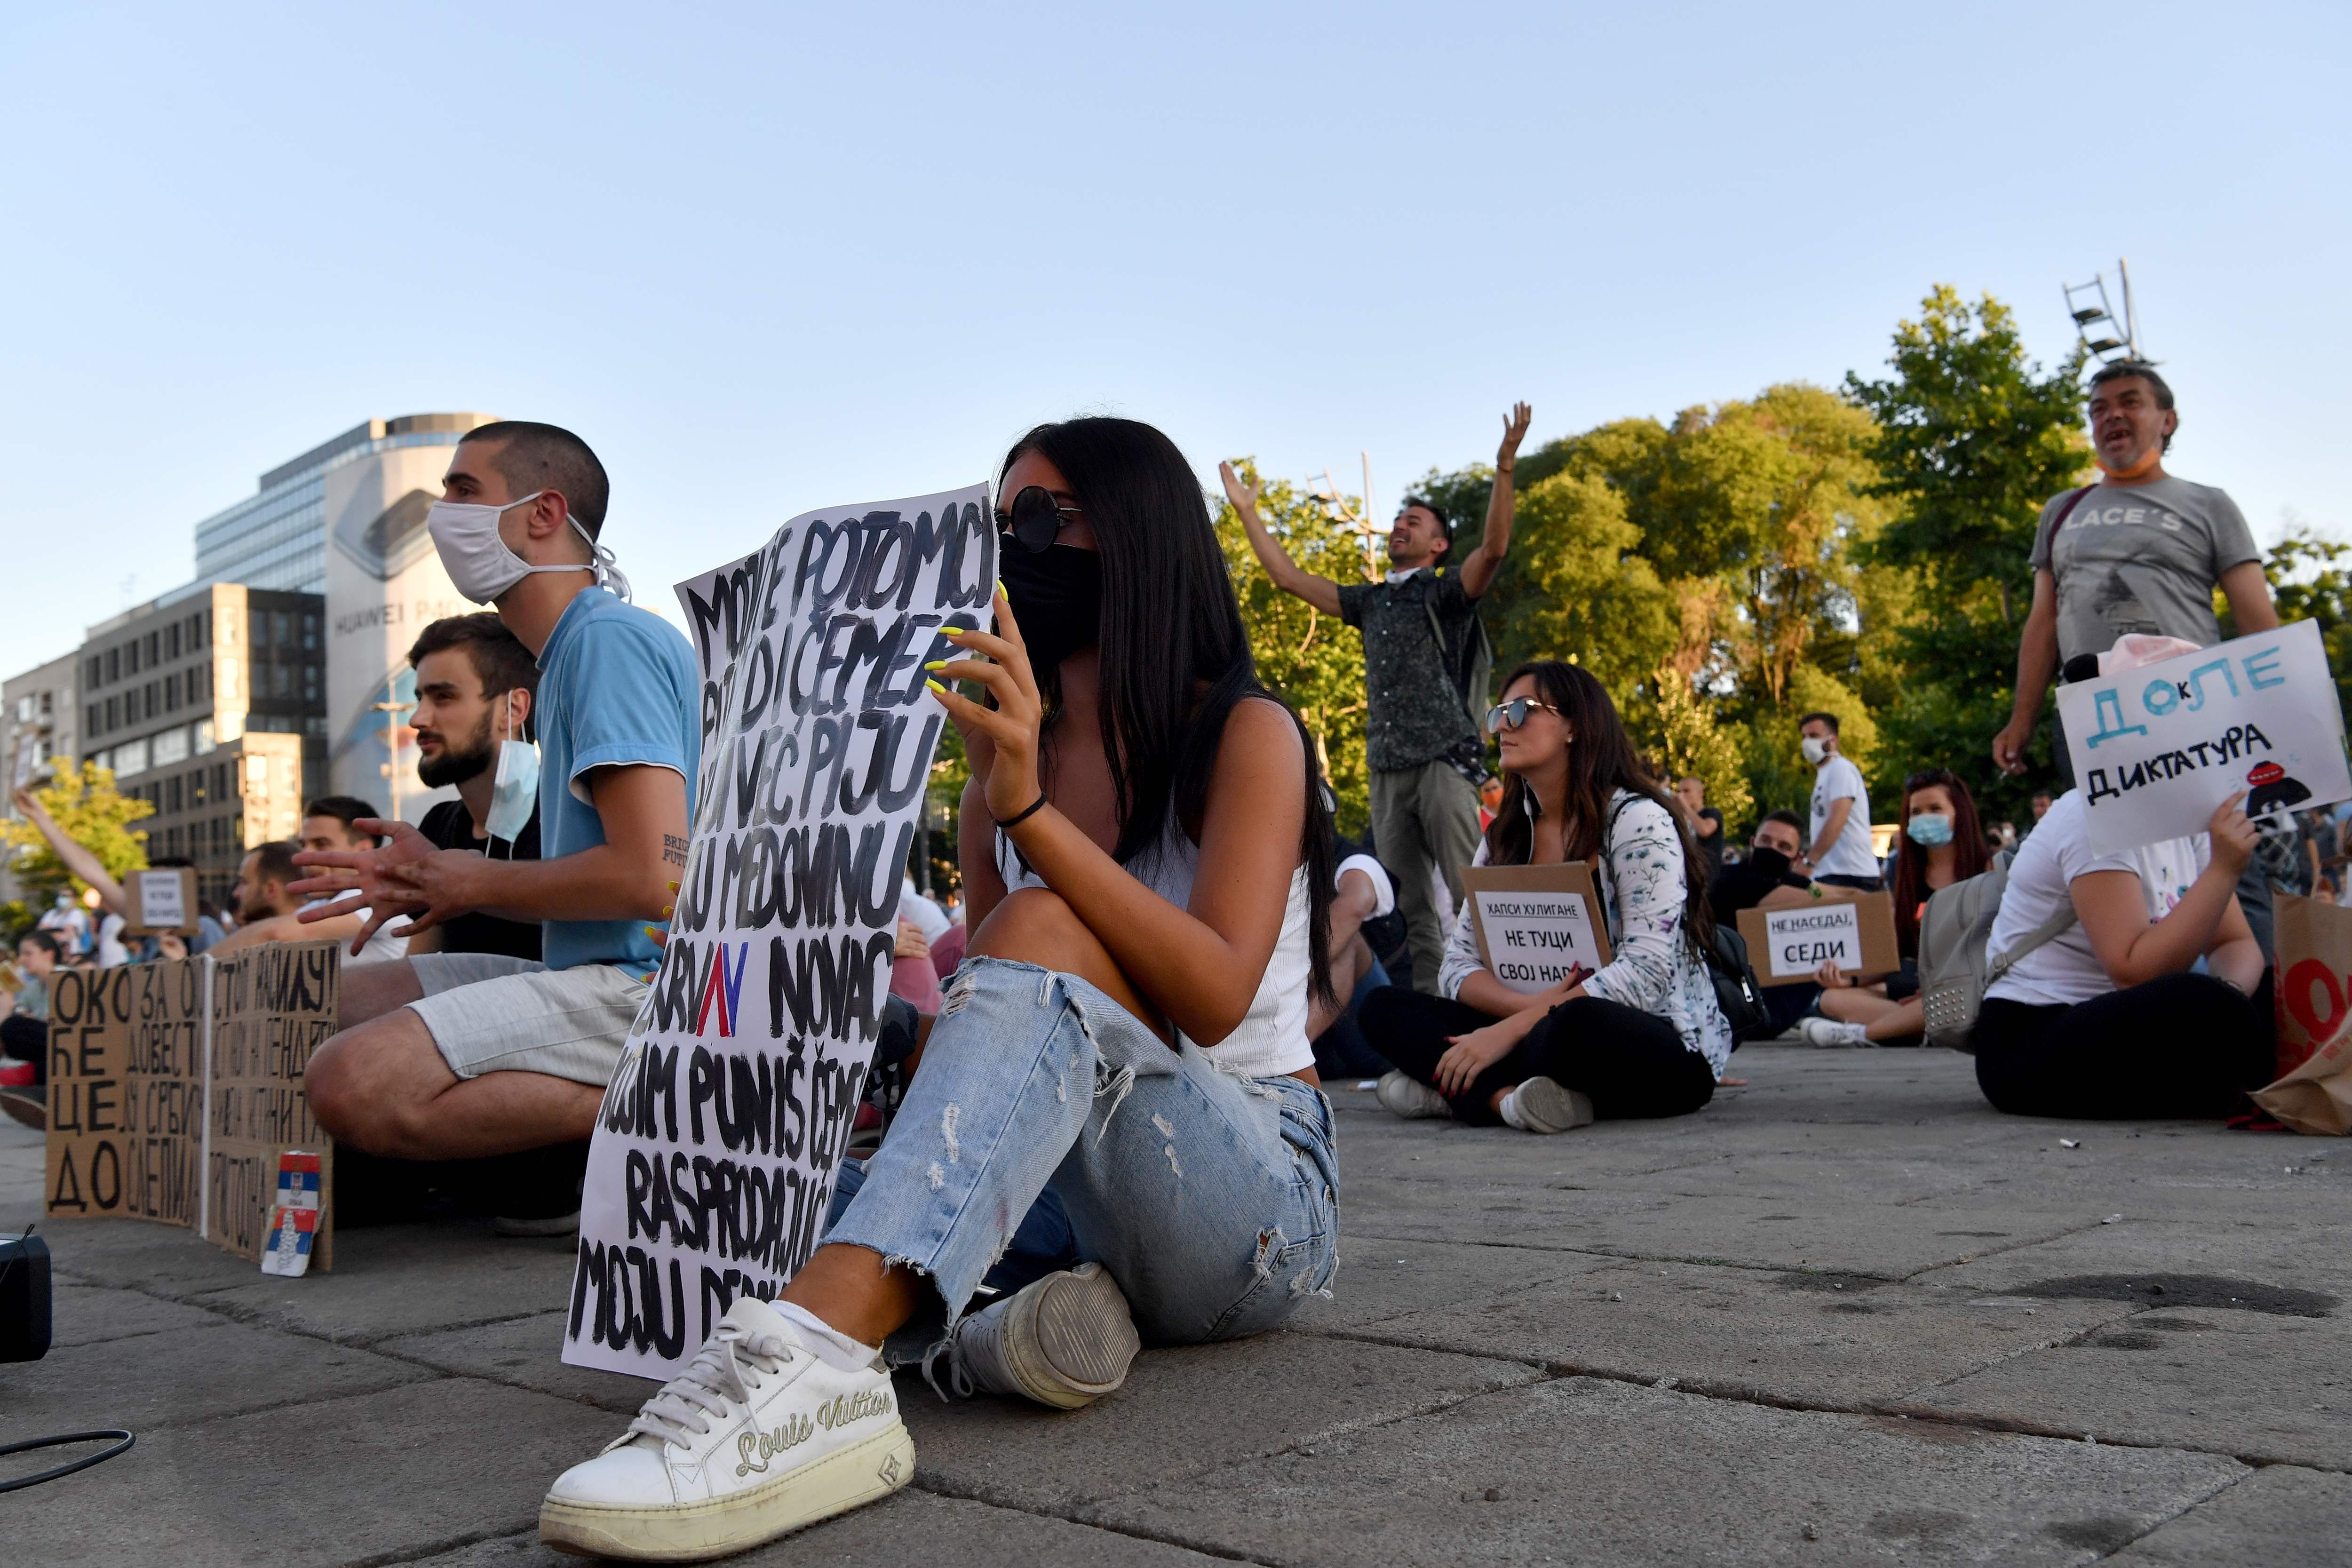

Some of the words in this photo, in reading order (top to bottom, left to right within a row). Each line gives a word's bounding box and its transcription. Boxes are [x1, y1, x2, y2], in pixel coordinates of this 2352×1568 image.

[791, 496, 995, 617] POTOMCI
[799, 710, 940, 820] PIJU
[2087, 723, 2272, 806] ДИКТАТУРА
[662, 849, 688, 868] FUTU
[664, 834, 689, 852] BRIG
[1486, 903, 1521, 915] ХАПСИ
[1523, 904, 1578, 916] ХУЛИГАНЕ
[1505, 930, 1526, 947] НЕ
[1528, 931, 1573, 952] ТУЦИ
[1771, 920, 1787, 931] НЕ
[1499, 963, 1536, 981] СВОЈ
[1539, 965, 1572, 981] НАР
[1784, 940, 1845, 965] СЕДИ
[141, 964, 168, 1021] ЗА
[648, 937, 749, 1037] KRVAV
[769, 931, 894, 1044] NOVAC
[52, 1027, 105, 1076] ЋЕ
[689, 1033, 805, 1162] PUNIŠ
[48, 1140, 121, 1212] ДО
[626, 1149, 832, 1280] RASPRODAJUĆ
[568, 1235, 685, 1360] MOJU
[735, 1413, 814, 1477] Louis
[817, 1388, 893, 1431] Vuitton
